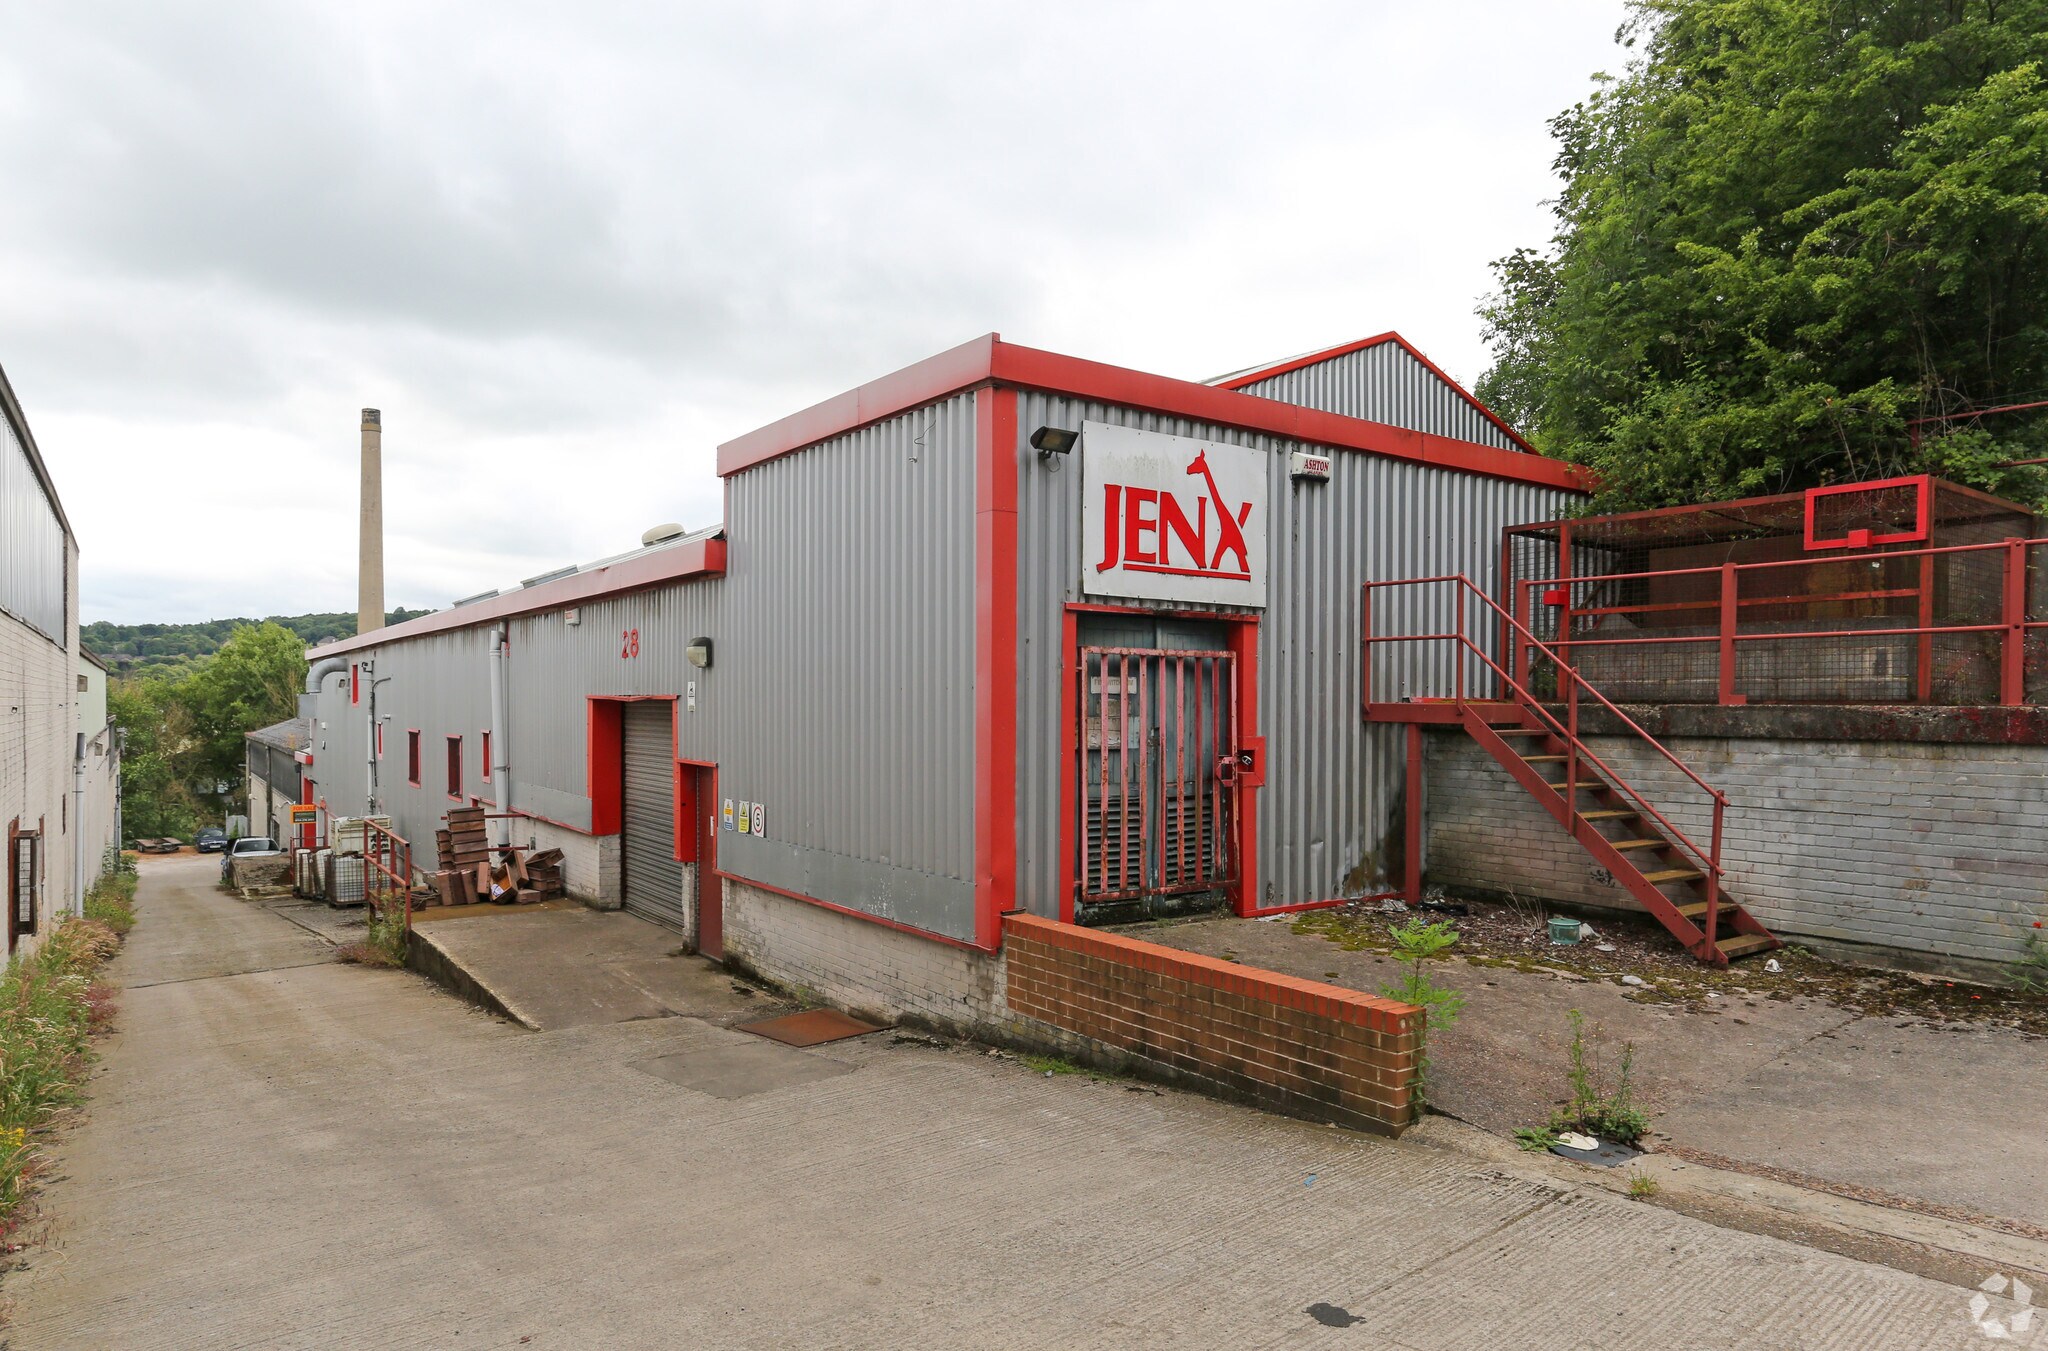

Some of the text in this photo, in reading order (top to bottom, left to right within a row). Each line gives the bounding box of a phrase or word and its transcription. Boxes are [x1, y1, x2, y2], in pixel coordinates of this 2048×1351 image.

[1304, 459, 1329, 472] ASHTON
[1096, 449, 1252, 574] JENX
[622, 628, 639, 658] 28
[756, 812, 760, 826] 5
